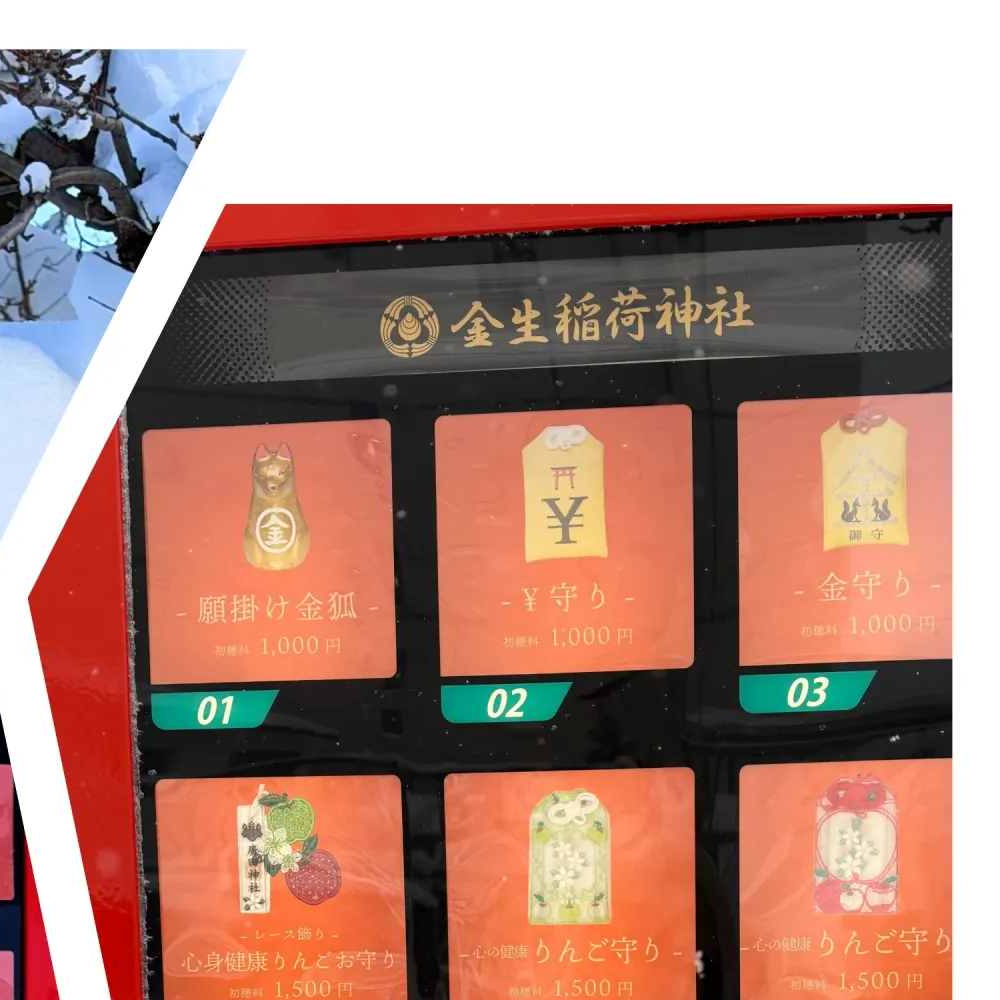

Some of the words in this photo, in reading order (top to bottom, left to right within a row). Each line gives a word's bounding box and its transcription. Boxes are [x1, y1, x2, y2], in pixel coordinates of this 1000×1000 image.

[451, 285, 755, 348] 金生稲荷神社
[260, 515, 291, 547] 金
[816, 569, 911, 602] 金守り
[197, 592, 358, 625] 願掛け金狐
[486, 687, 528, 719] 02
[786, 676, 830, 708] 03
[196, 695, 235, 726] 01
[254, 926, 324, 941] レース飾り
[752, 937, 812, 952] 心の健康
[819, 927, 951, 957] りんご守り
[181, 949, 395, 973] 心身健康りんごお守り
[472, 944, 528, 959] 心の健康
[535, 936, 660, 965] りんご守り
